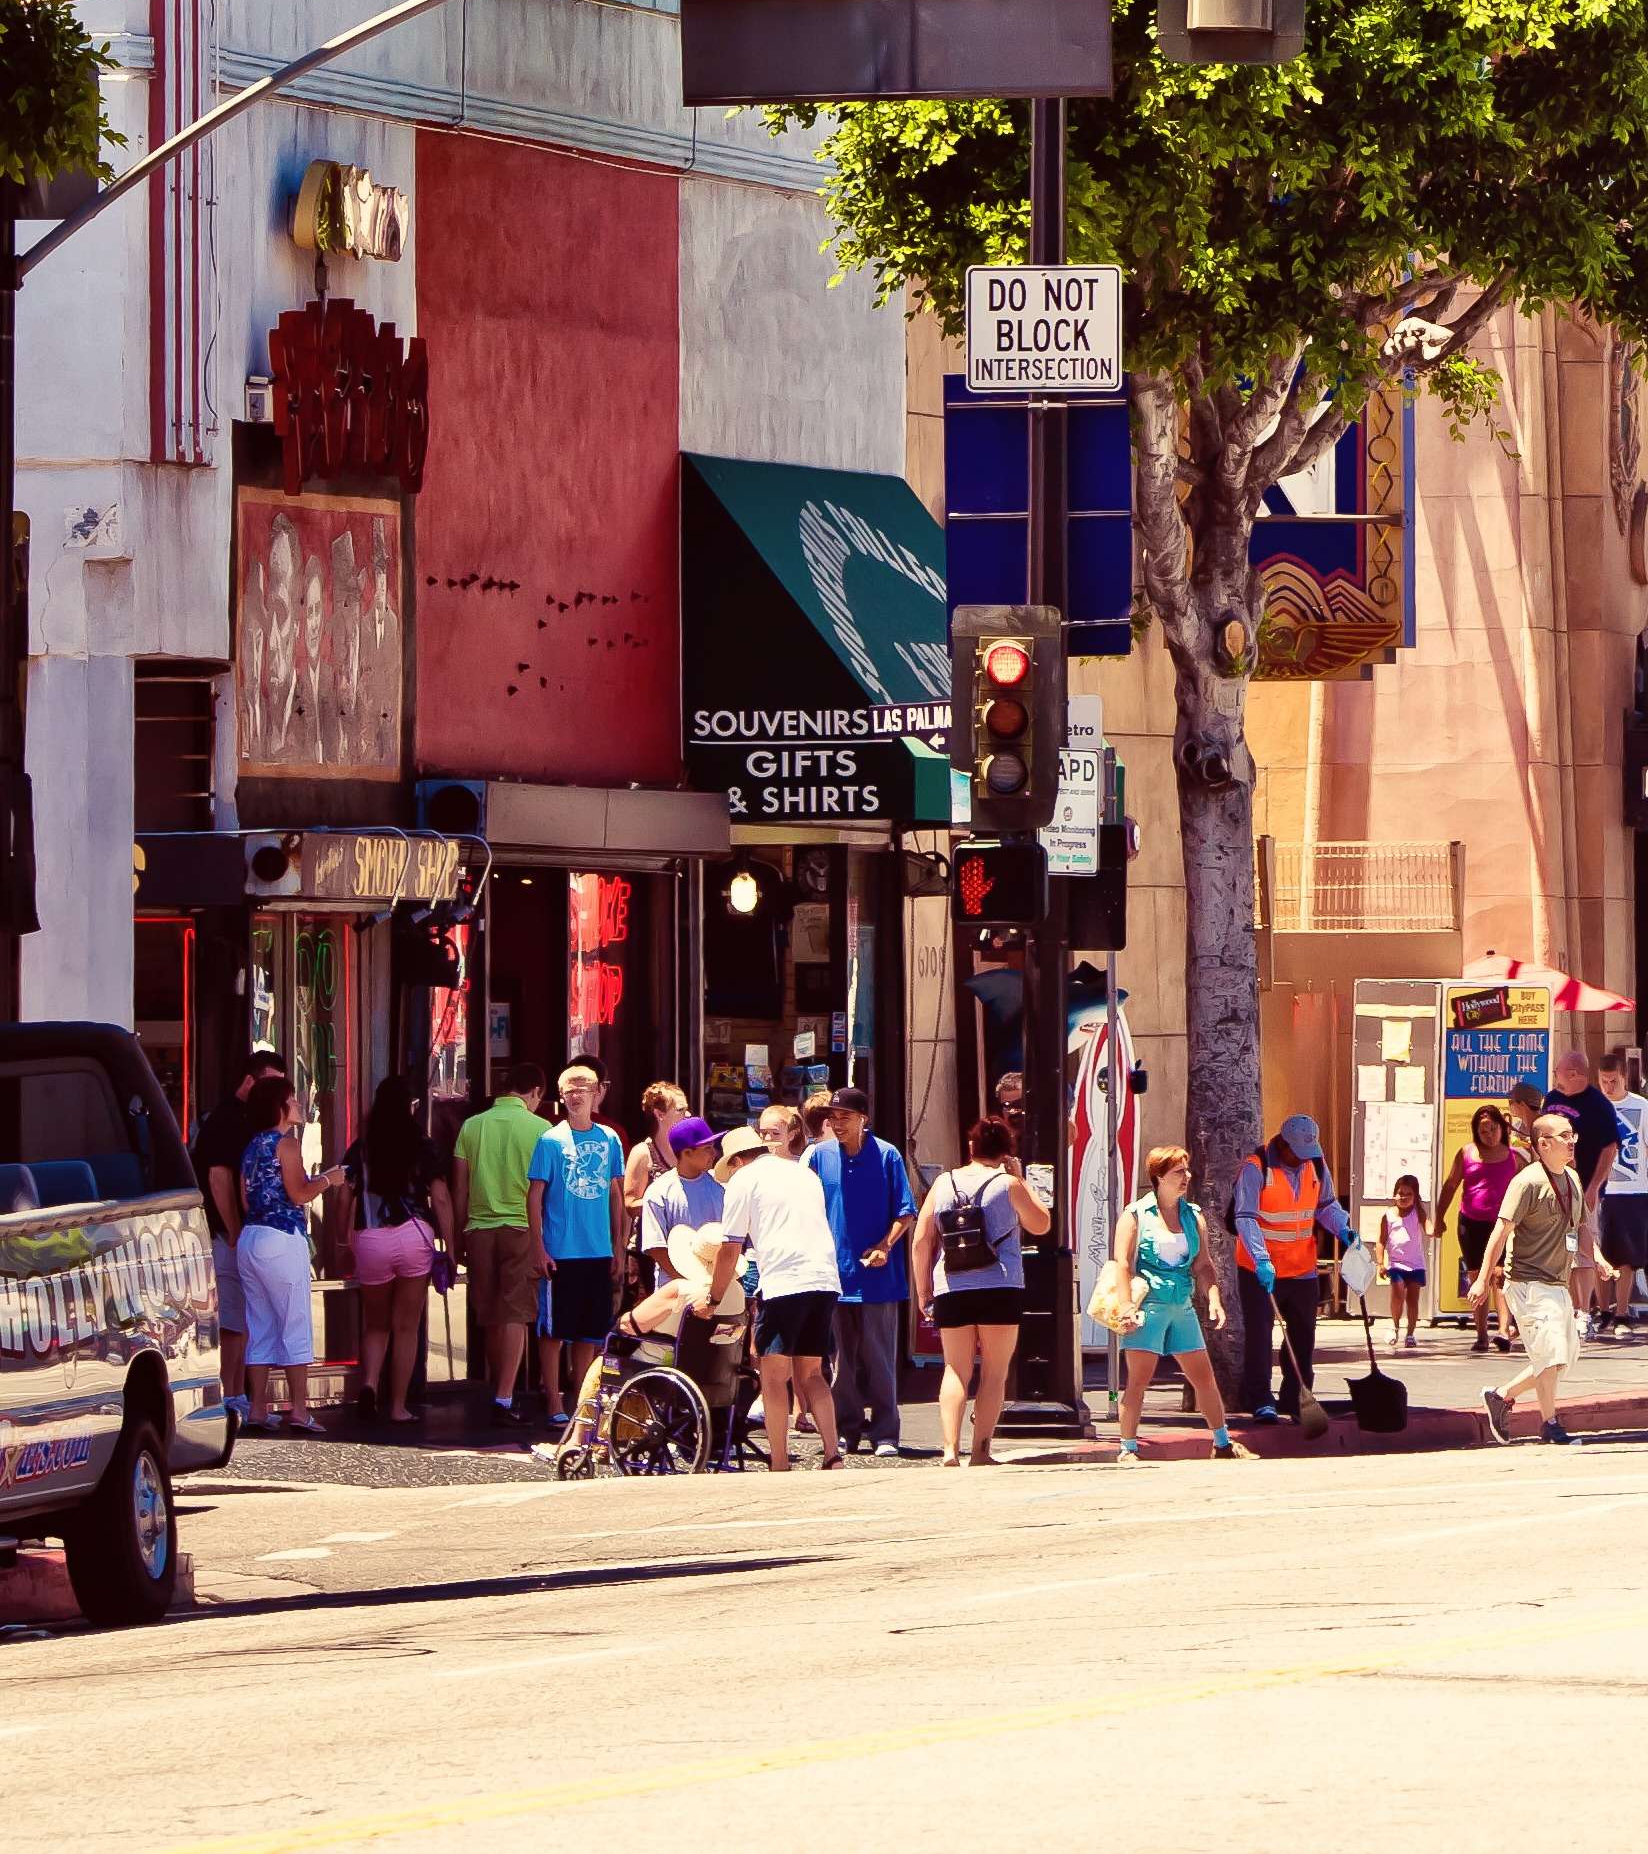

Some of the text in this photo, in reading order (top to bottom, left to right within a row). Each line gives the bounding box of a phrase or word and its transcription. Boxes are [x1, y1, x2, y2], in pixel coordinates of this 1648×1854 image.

[989, 277, 1099, 311] DO NOT
[996, 318, 1091, 352] BLOCK
[975, 357, 1112, 381] INTERSECTION
[694, 710, 869, 737] SOUVENIRS
[872, 707, 902, 734] LAS
[746, 750, 857, 778] GIFTS
[728, 785, 880, 814] & SHIRTS
[1451, 1033, 1545, 1052] ALL THE FAME
[1458, 1054, 1538, 1073] WITHOUT THE
